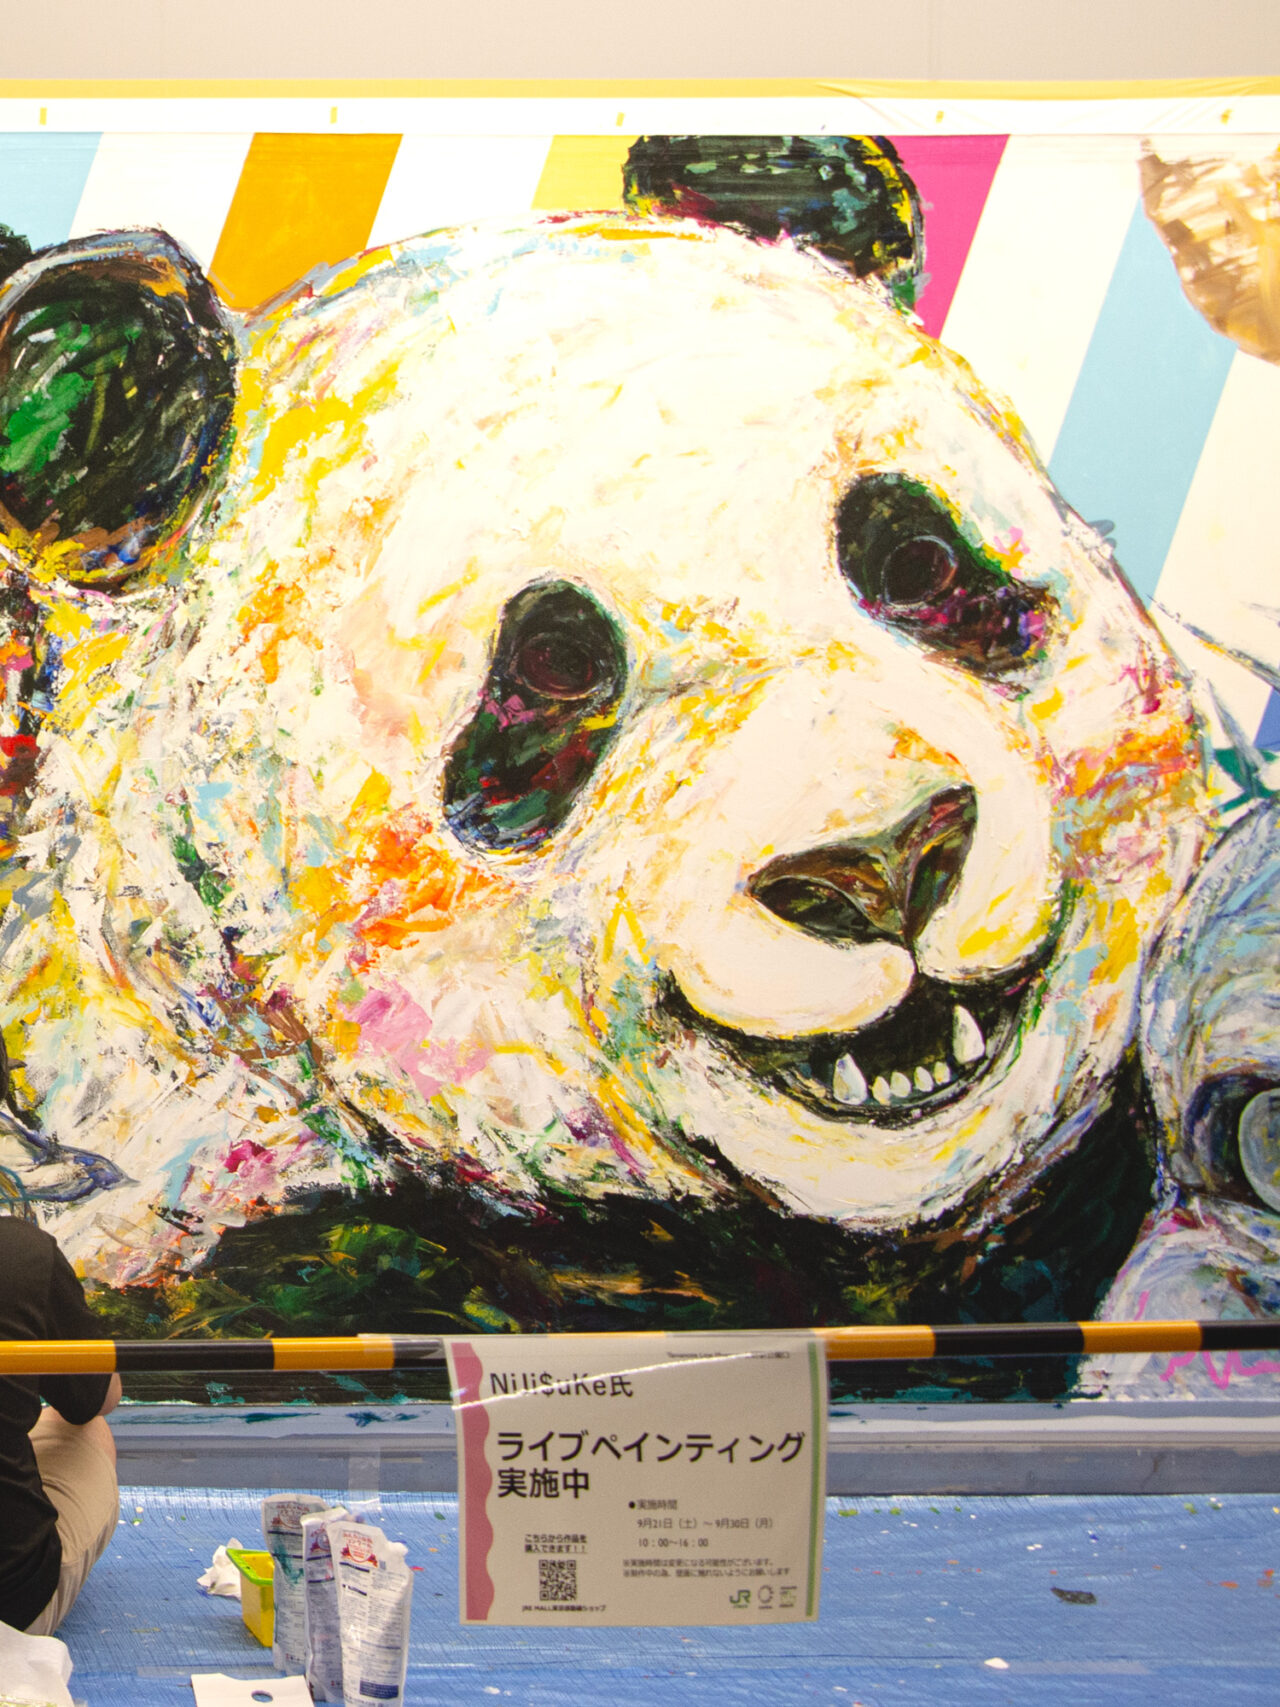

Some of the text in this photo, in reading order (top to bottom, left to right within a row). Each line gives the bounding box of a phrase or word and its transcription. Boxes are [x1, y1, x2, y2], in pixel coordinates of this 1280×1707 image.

[498, 1430, 806, 1464] ライブペインティング
[498, 1467, 590, 1499] 実施中
[729, 1589, 751, 1605] JR
